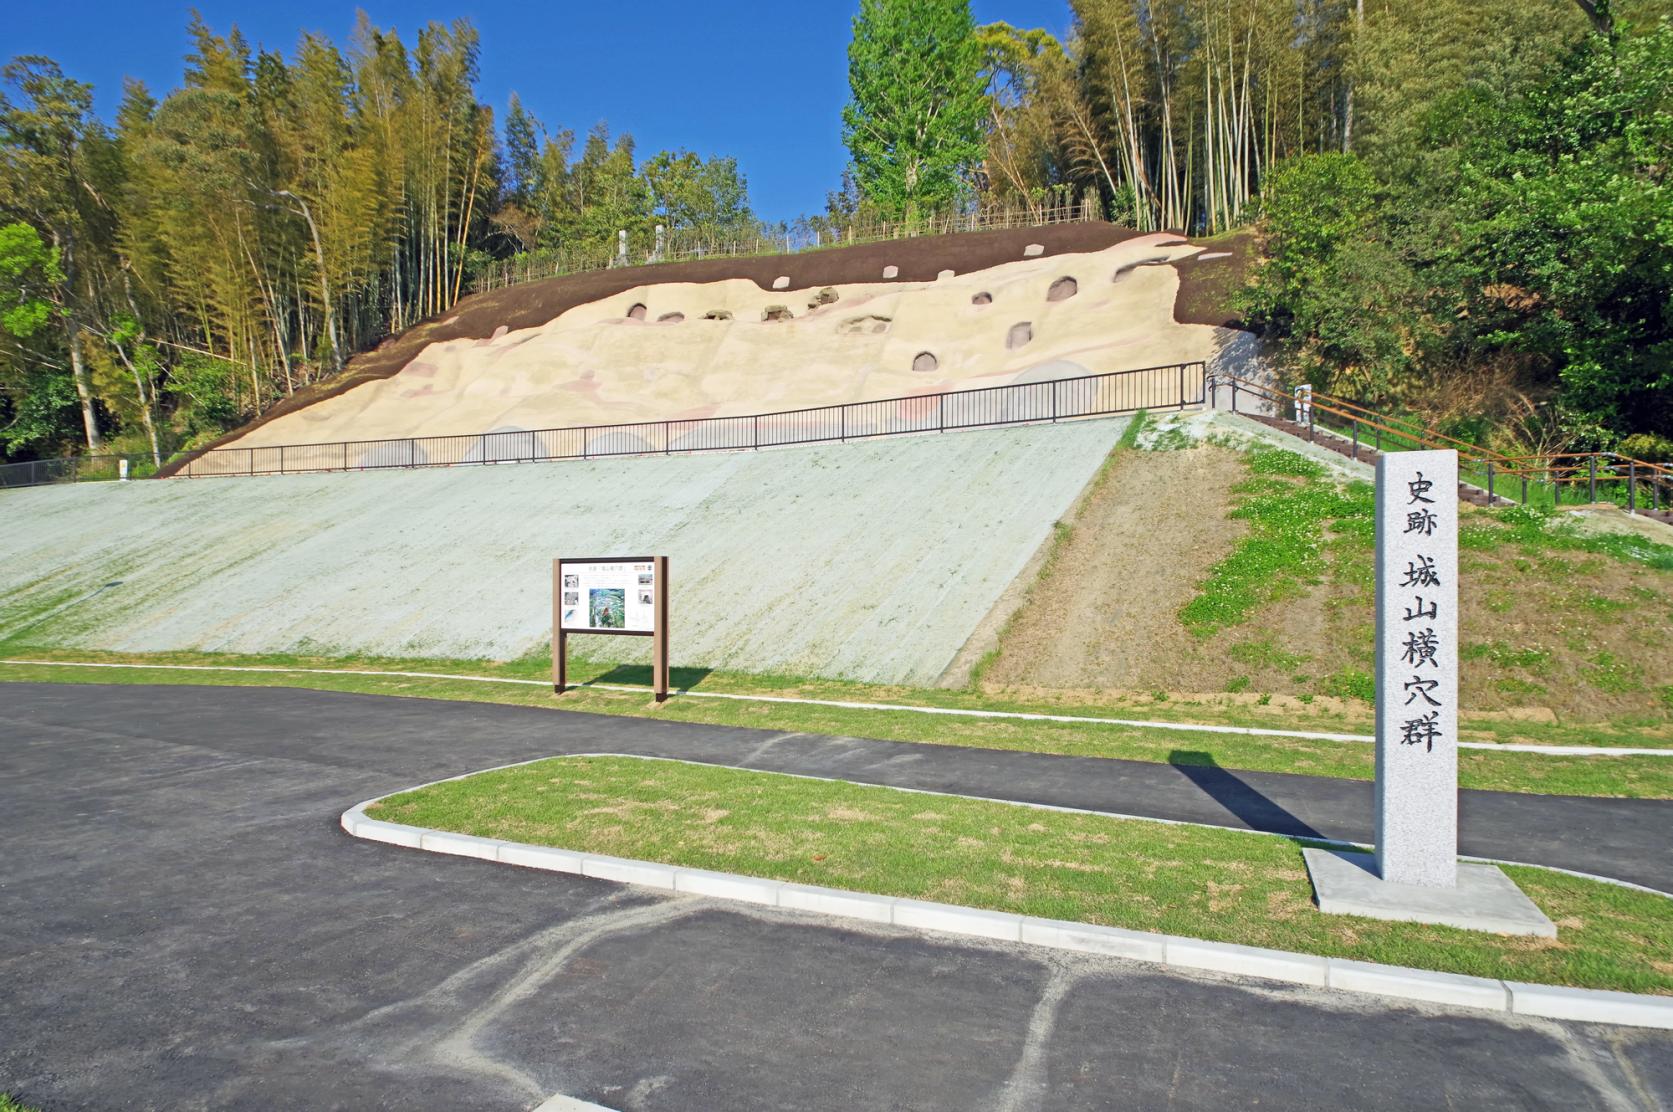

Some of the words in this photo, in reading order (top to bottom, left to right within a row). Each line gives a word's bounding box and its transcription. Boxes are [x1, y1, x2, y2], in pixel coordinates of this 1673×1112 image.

[1403, 471, 1437, 536] 史跡
[1400, 554, 1442, 753] 城山横穴群
